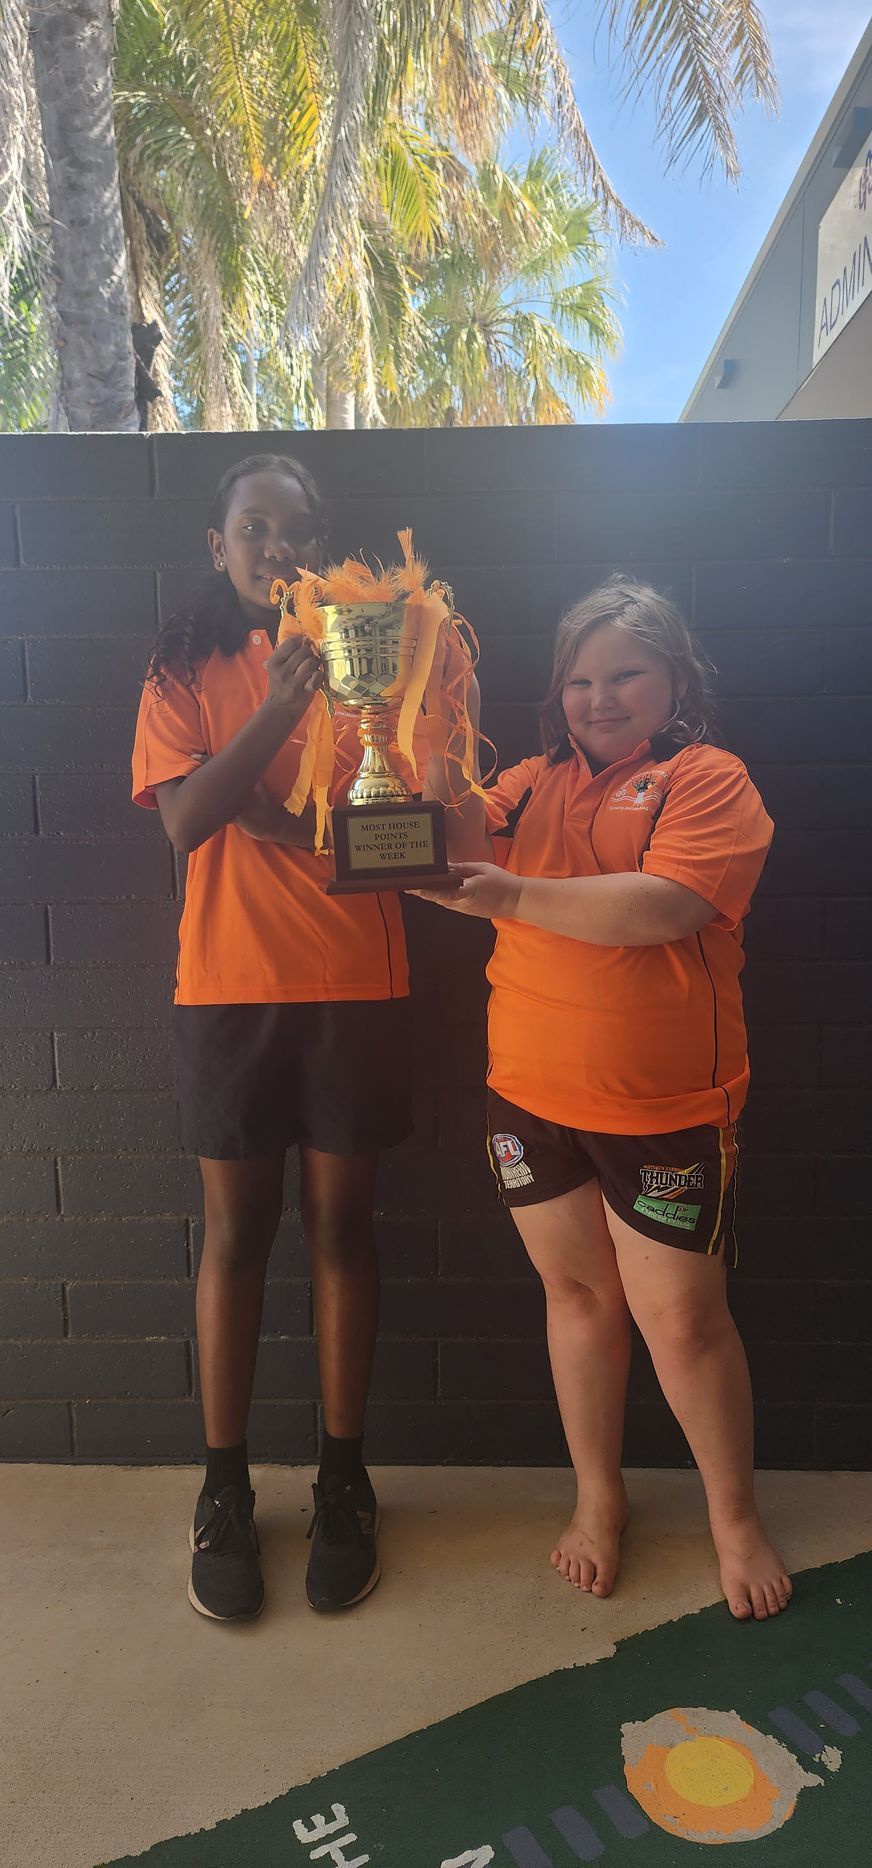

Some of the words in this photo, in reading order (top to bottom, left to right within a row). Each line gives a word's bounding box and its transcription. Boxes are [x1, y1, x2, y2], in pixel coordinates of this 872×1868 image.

[361, 823, 386, 831] MOST
[389, 821, 420, 829] HOUSE
[374, 832, 408, 841] POINTS
[354, 843, 393, 852] WINNER
[410, 840, 429, 848] THE
[379, 852, 406, 861] WEEK
[495, 1140, 520, 1158] AFL
[503, 1173, 535, 1189] TERRITORY
[640, 1169, 704, 1189] THUNDER
[637, 1200, 696, 1224] caddies
